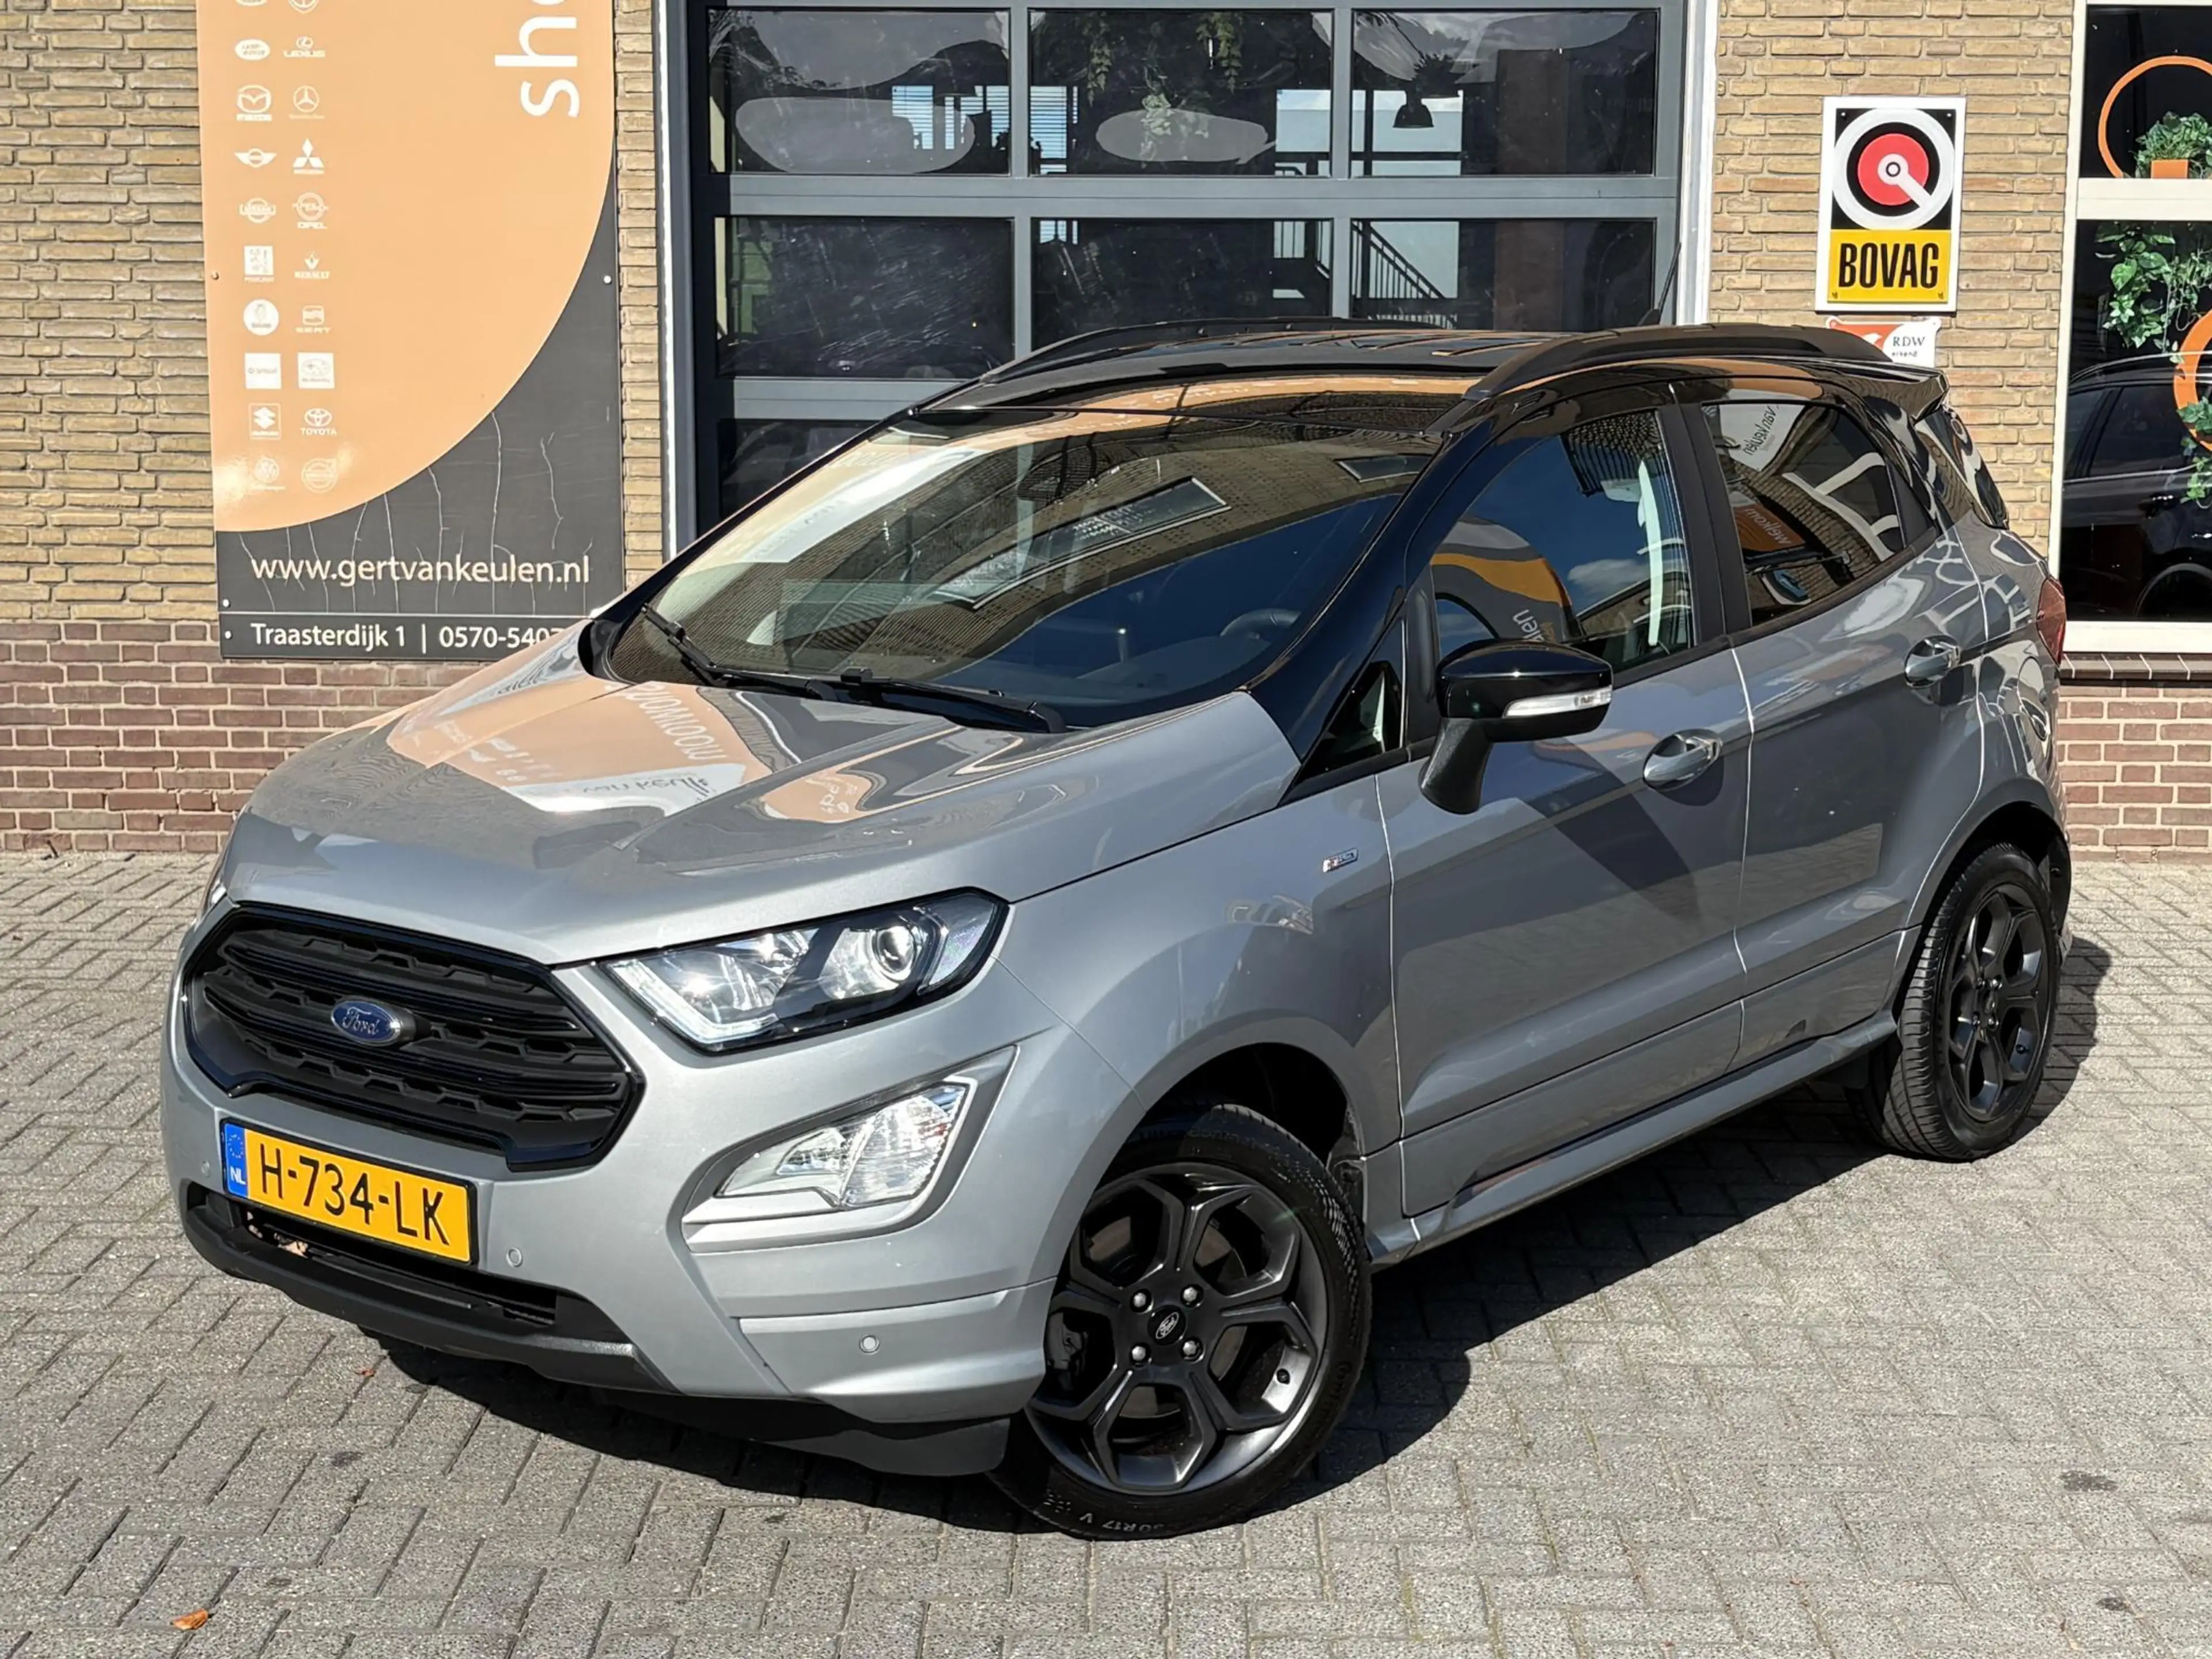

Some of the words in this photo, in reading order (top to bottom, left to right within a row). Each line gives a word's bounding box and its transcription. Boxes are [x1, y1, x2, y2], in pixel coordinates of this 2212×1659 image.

[494, 0, 580, 118] sh
[1838, 242, 1940, 289] BOVAG
[1893, 336, 1926, 347] RDW
[299, 427, 338, 437] TOYOTA
[252, 555, 590, 588] www.gertvankeulen.nl
[252, 623, 388, 652] Traasterdijk
[395, 626, 405, 647] 1
[342, 1006, 381, 1036] Ford
[230, 1167, 246, 1185] NL
[259, 1142, 450, 1246] H-734-LK
